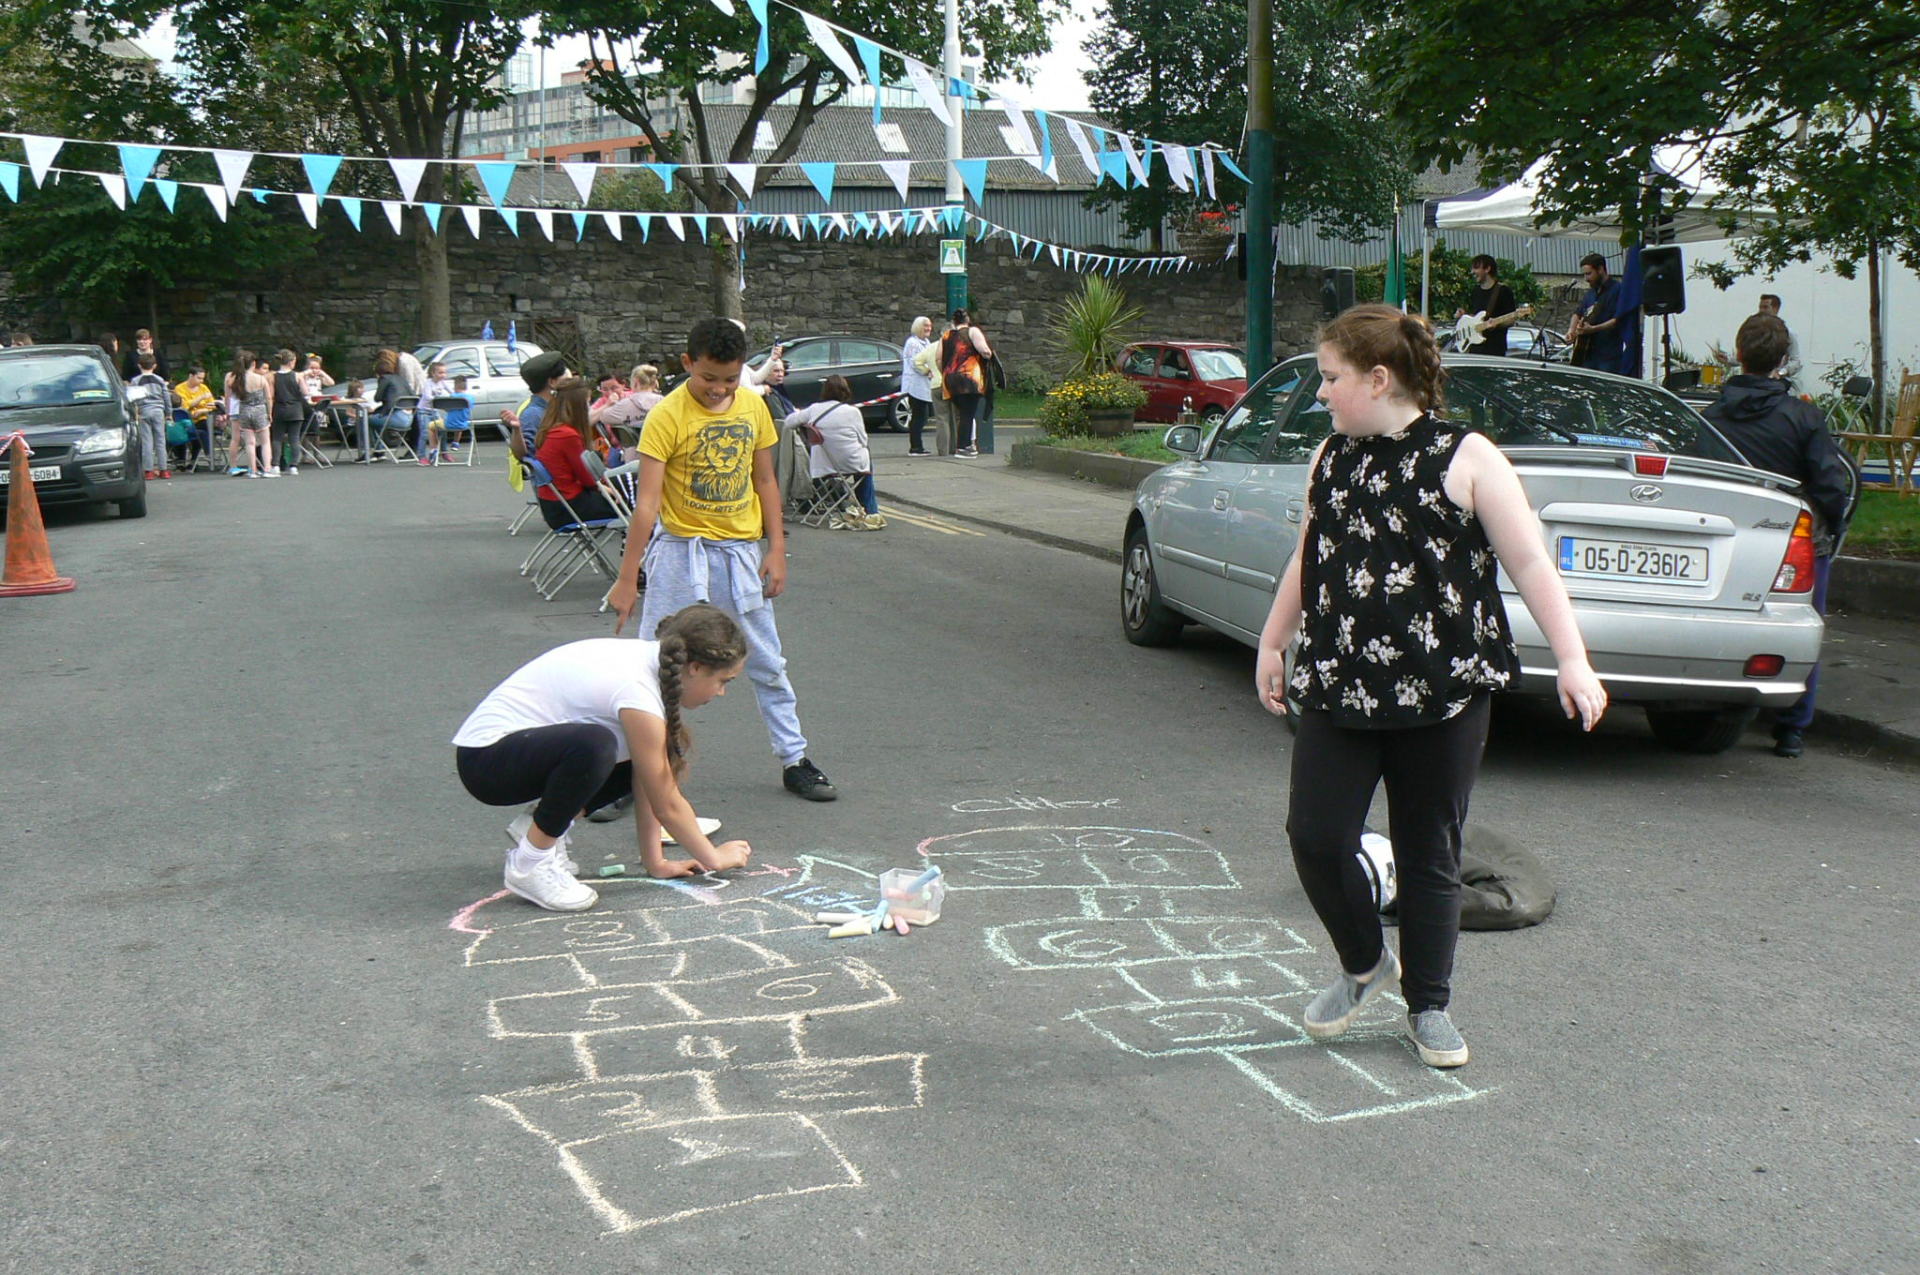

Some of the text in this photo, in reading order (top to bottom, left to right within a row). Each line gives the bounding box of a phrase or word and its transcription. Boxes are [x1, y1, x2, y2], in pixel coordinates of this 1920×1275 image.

[1584, 546, 1691, 578] 05-D-23612
[1037, 928, 1128, 958] 6
[577, 994, 634, 1022] 5
[674, 1034, 739, 1060] 4
